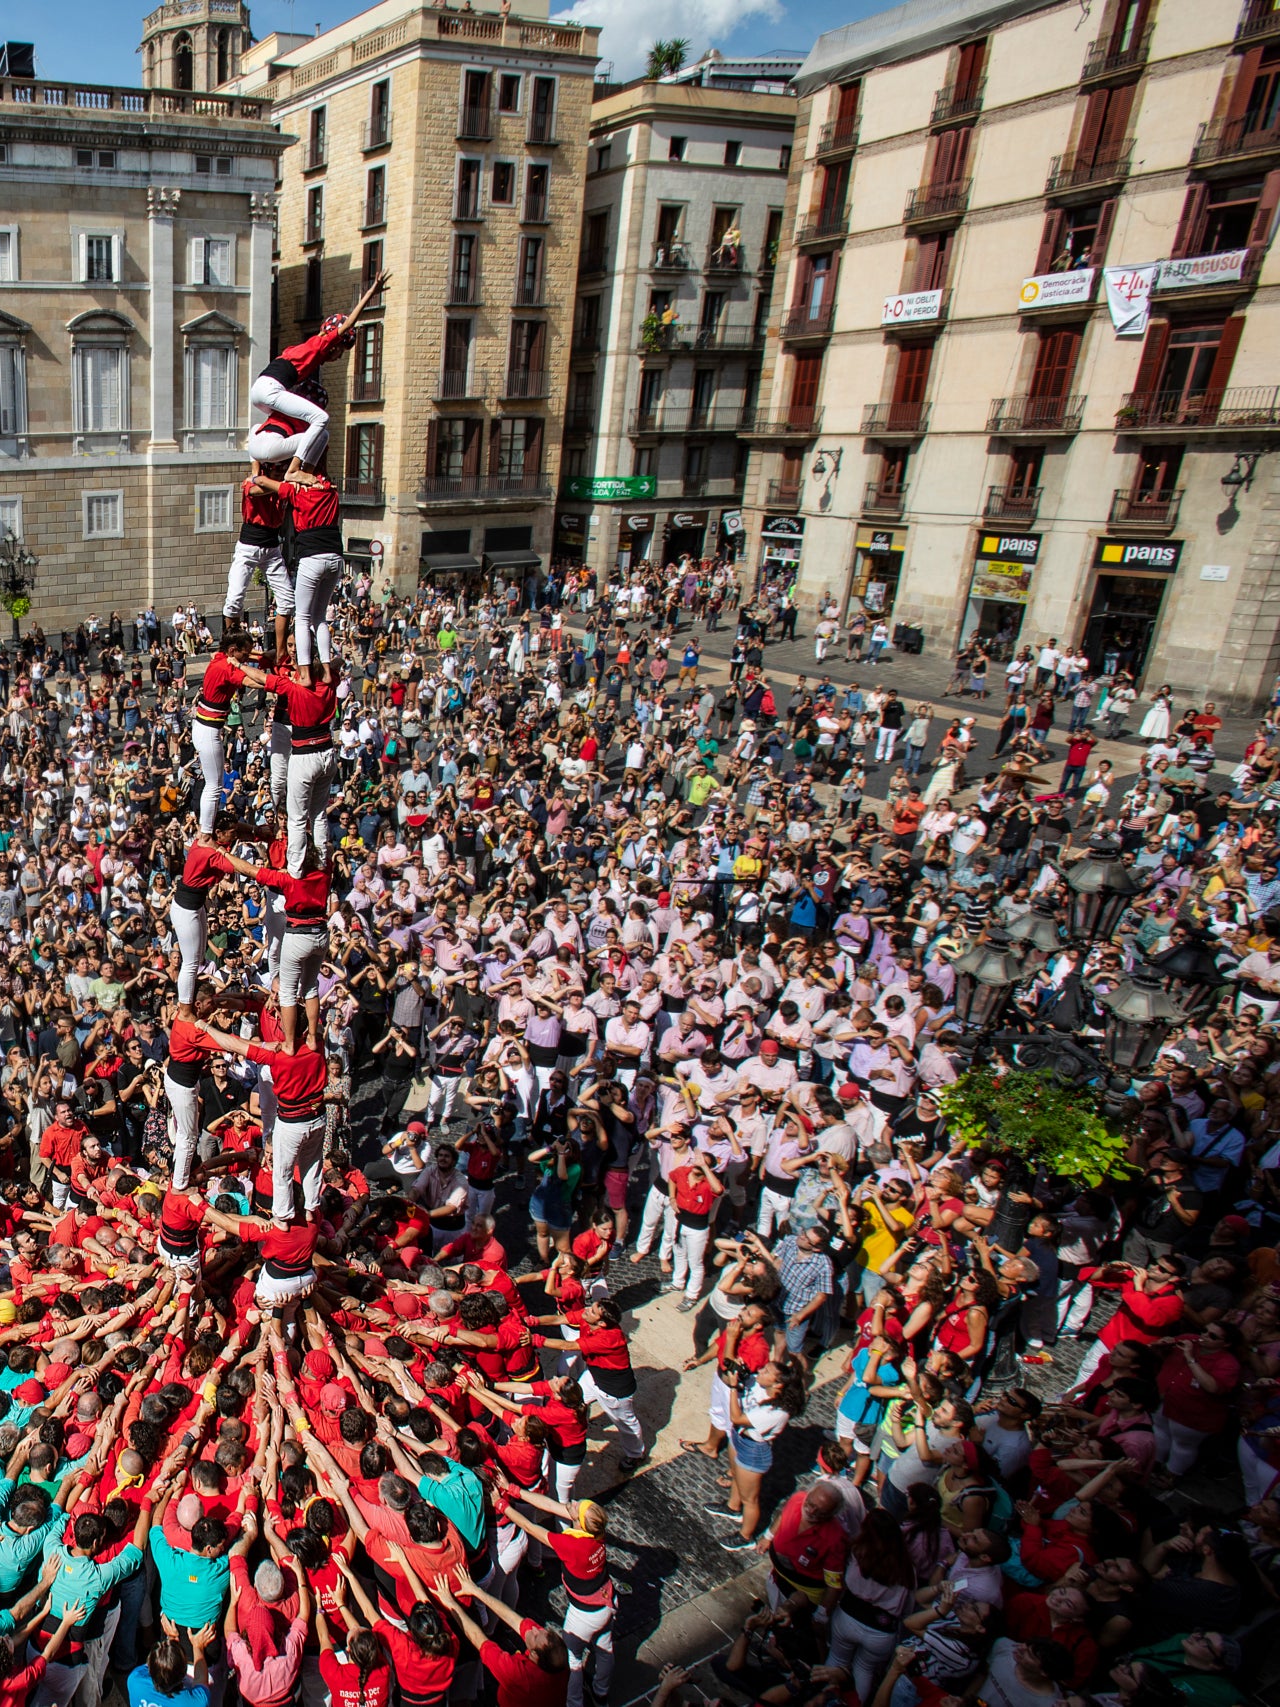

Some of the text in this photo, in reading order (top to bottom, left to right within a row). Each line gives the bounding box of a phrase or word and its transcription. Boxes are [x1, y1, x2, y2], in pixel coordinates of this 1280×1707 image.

[592, 480, 625, 489] SORTIDA
[585, 488, 609, 496] SALIDA
[869, 542, 890, 552] pans
[998, 537, 1038, 554] pans
[1123, 546, 1176, 563] pans
[368, 1686, 381, 1699] per
